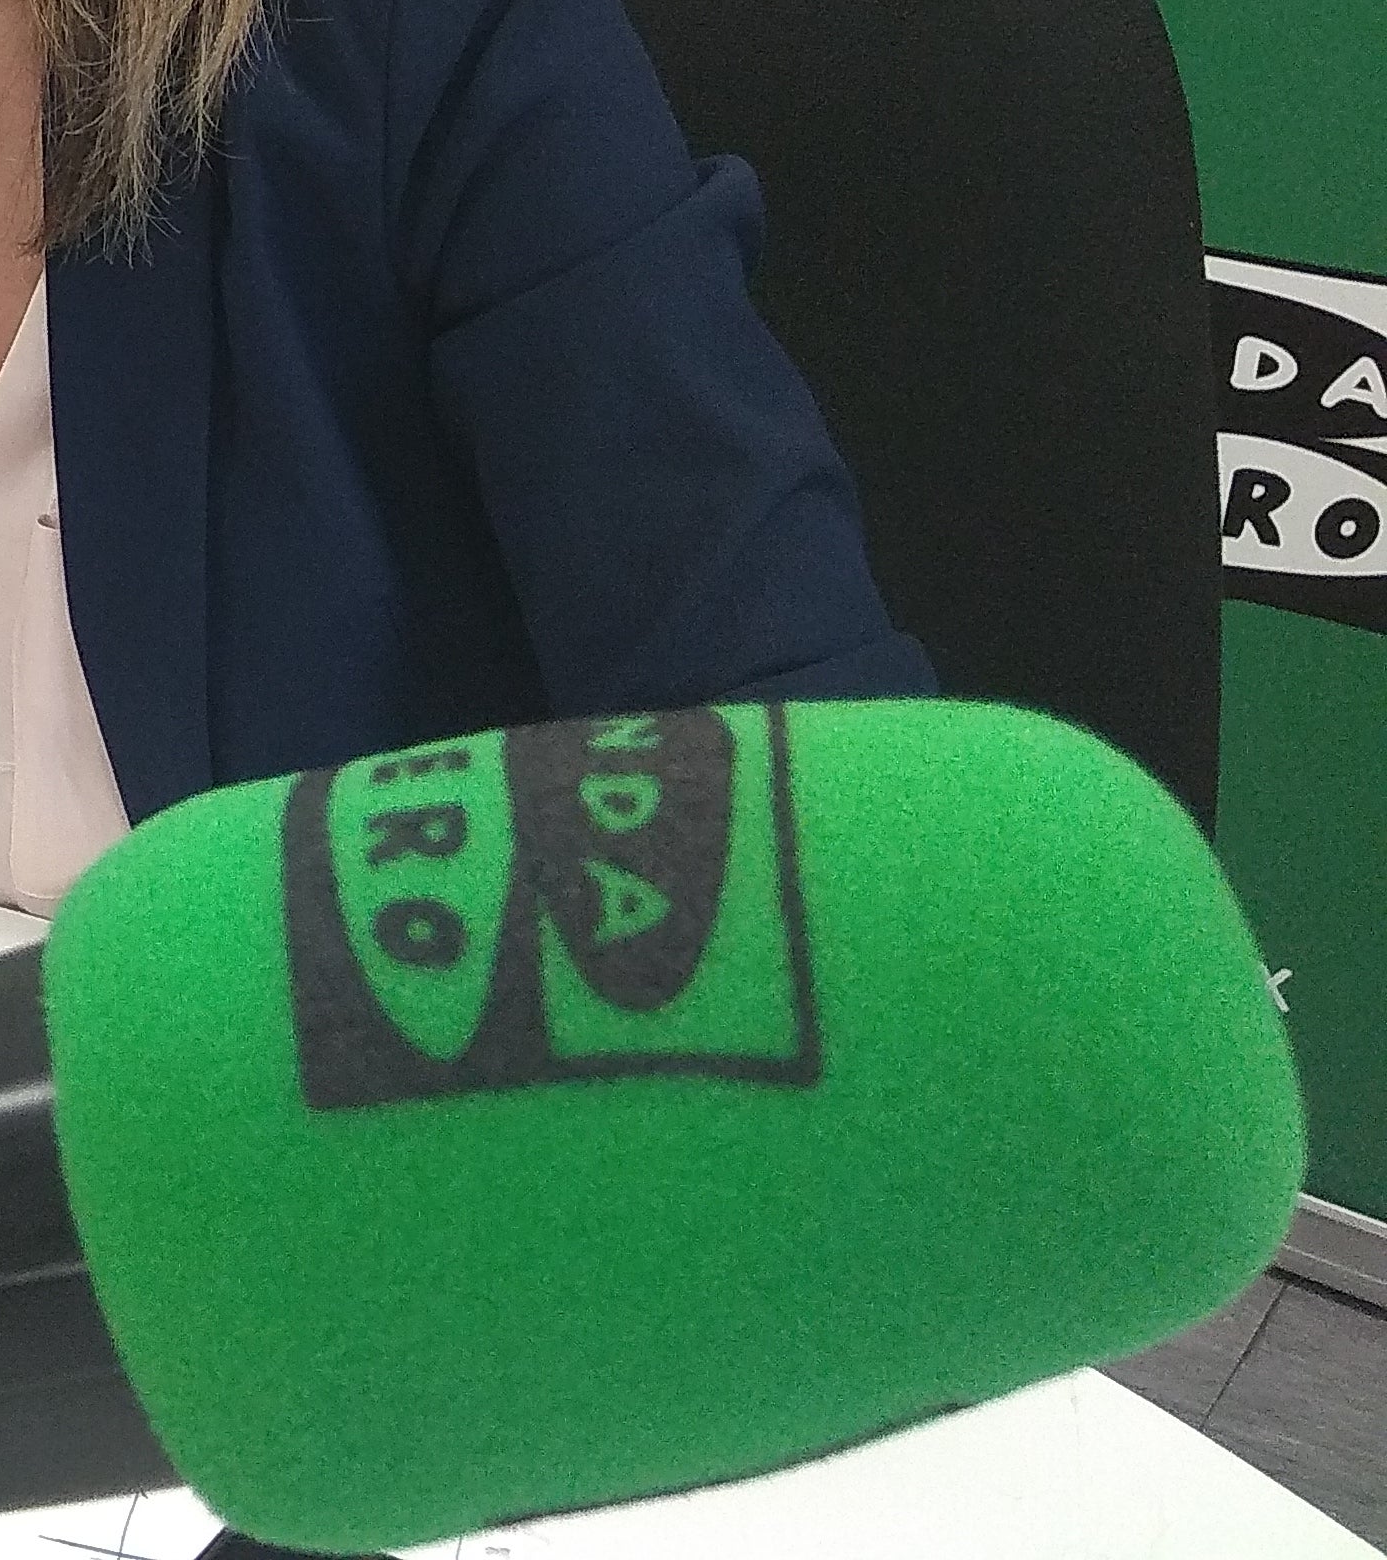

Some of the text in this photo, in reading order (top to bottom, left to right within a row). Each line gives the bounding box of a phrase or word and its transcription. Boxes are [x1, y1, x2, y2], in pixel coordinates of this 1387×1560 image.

[1230, 336, 1387, 417] DA
[1227, 468, 1380, 558] RO
[580, 714, 672, 943] NDA
